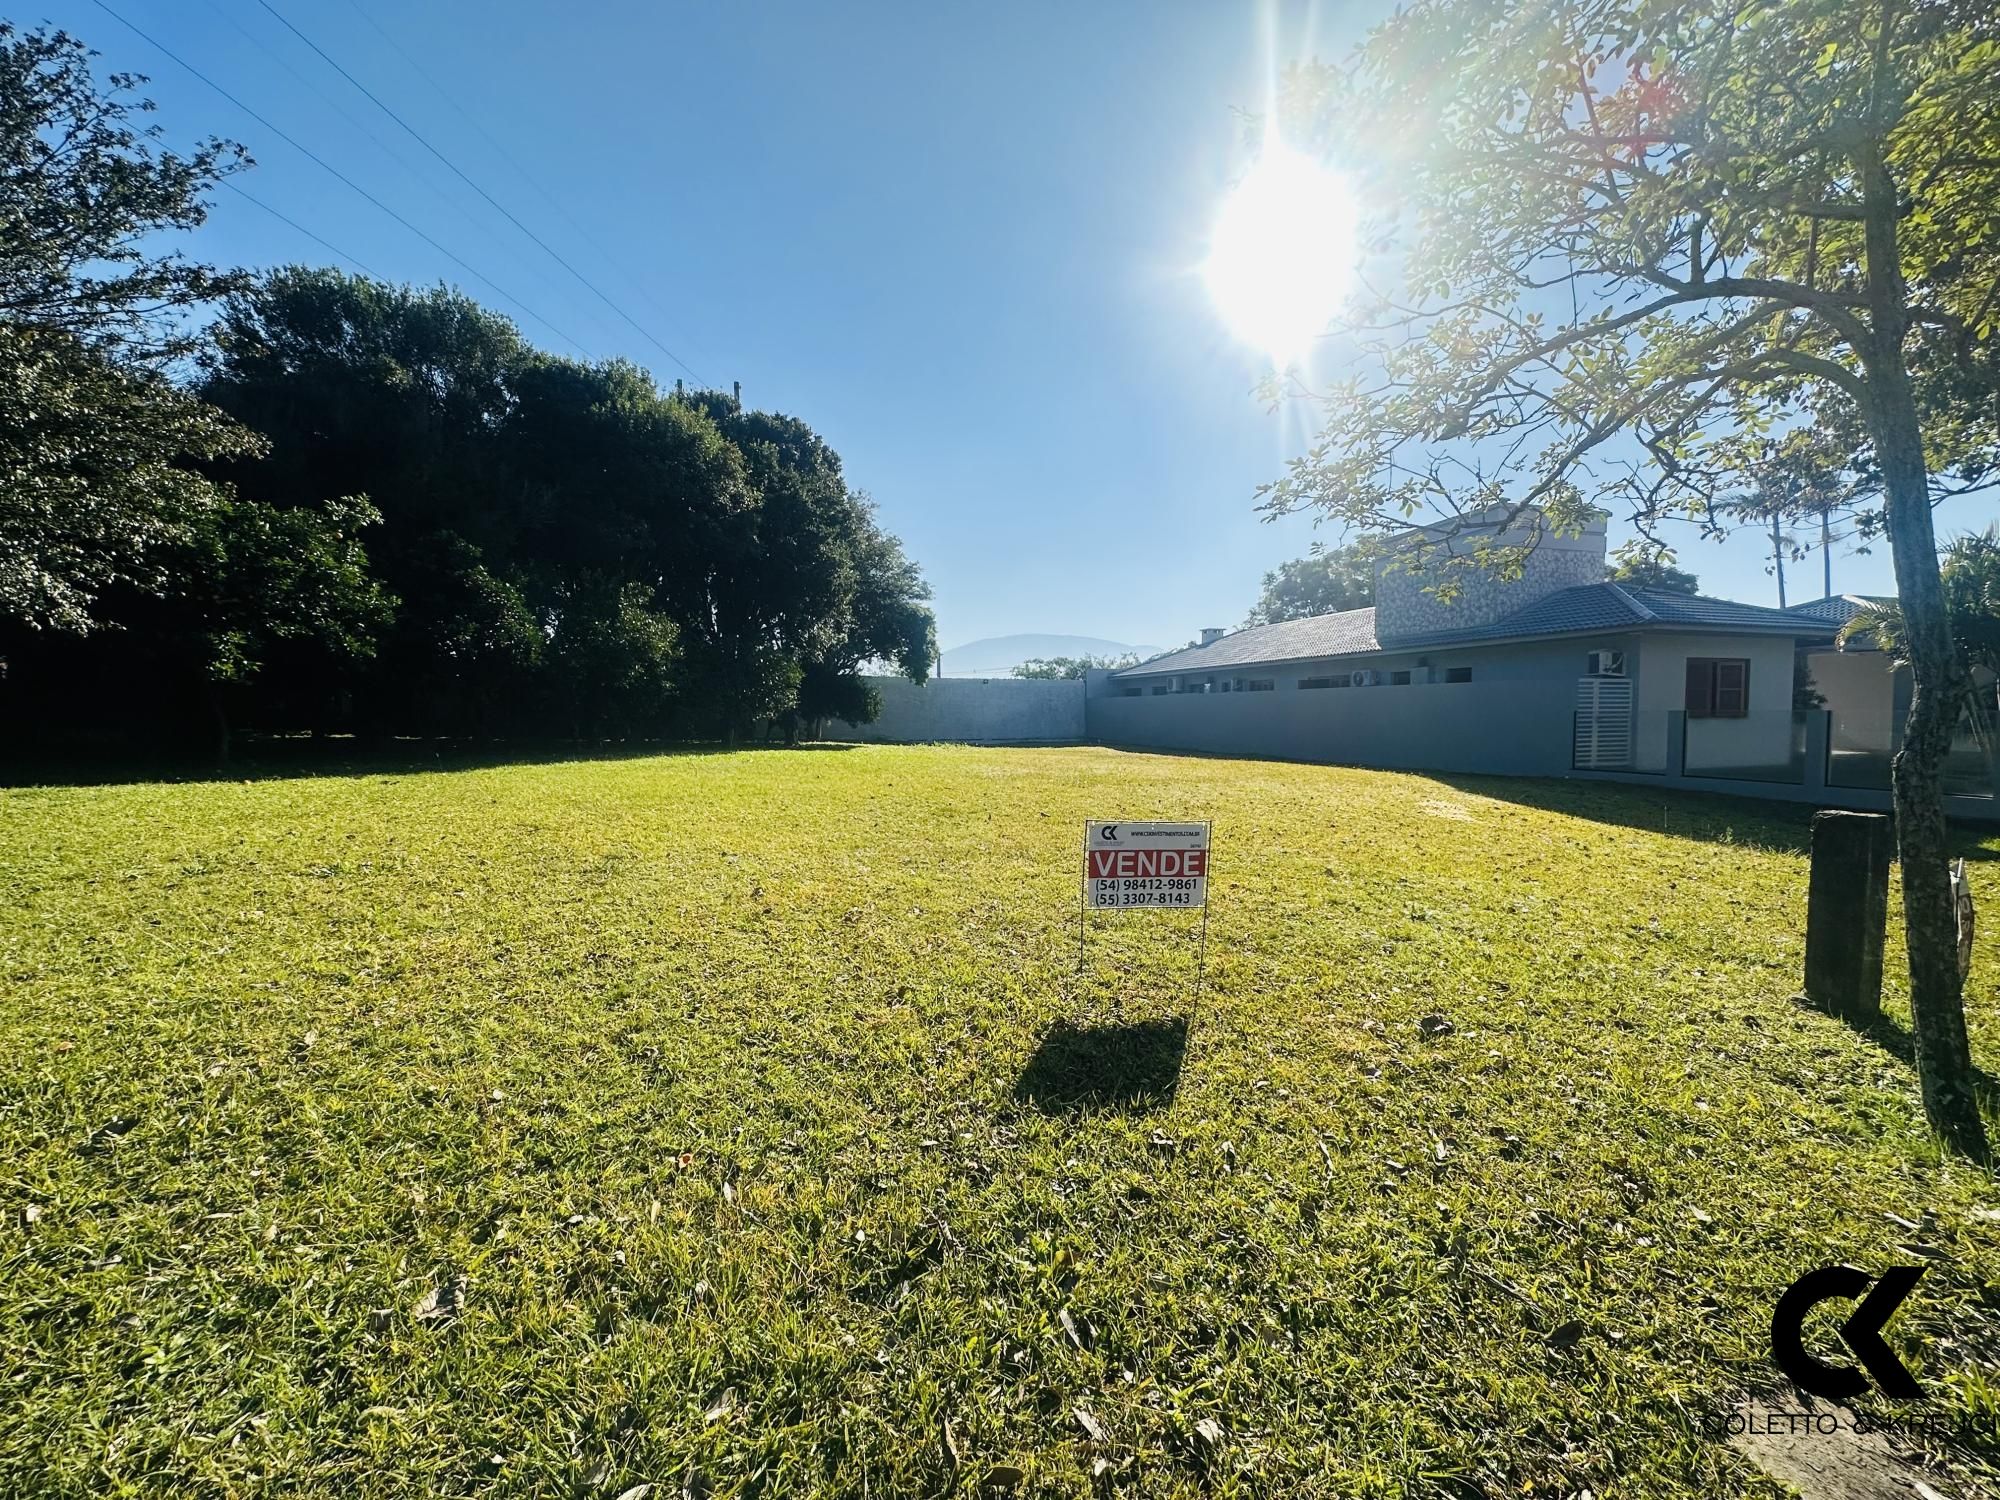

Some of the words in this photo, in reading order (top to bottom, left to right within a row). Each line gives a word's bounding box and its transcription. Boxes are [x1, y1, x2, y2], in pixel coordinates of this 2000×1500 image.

[1094, 851, 1201, 877] VENDE
[1095, 879, 1120, 892] (54)
[1123, 879, 1197, 890] 98412-9861
[1095, 893, 1119, 906] (55)
[1122, 893, 1190, 905] 3307-8143
